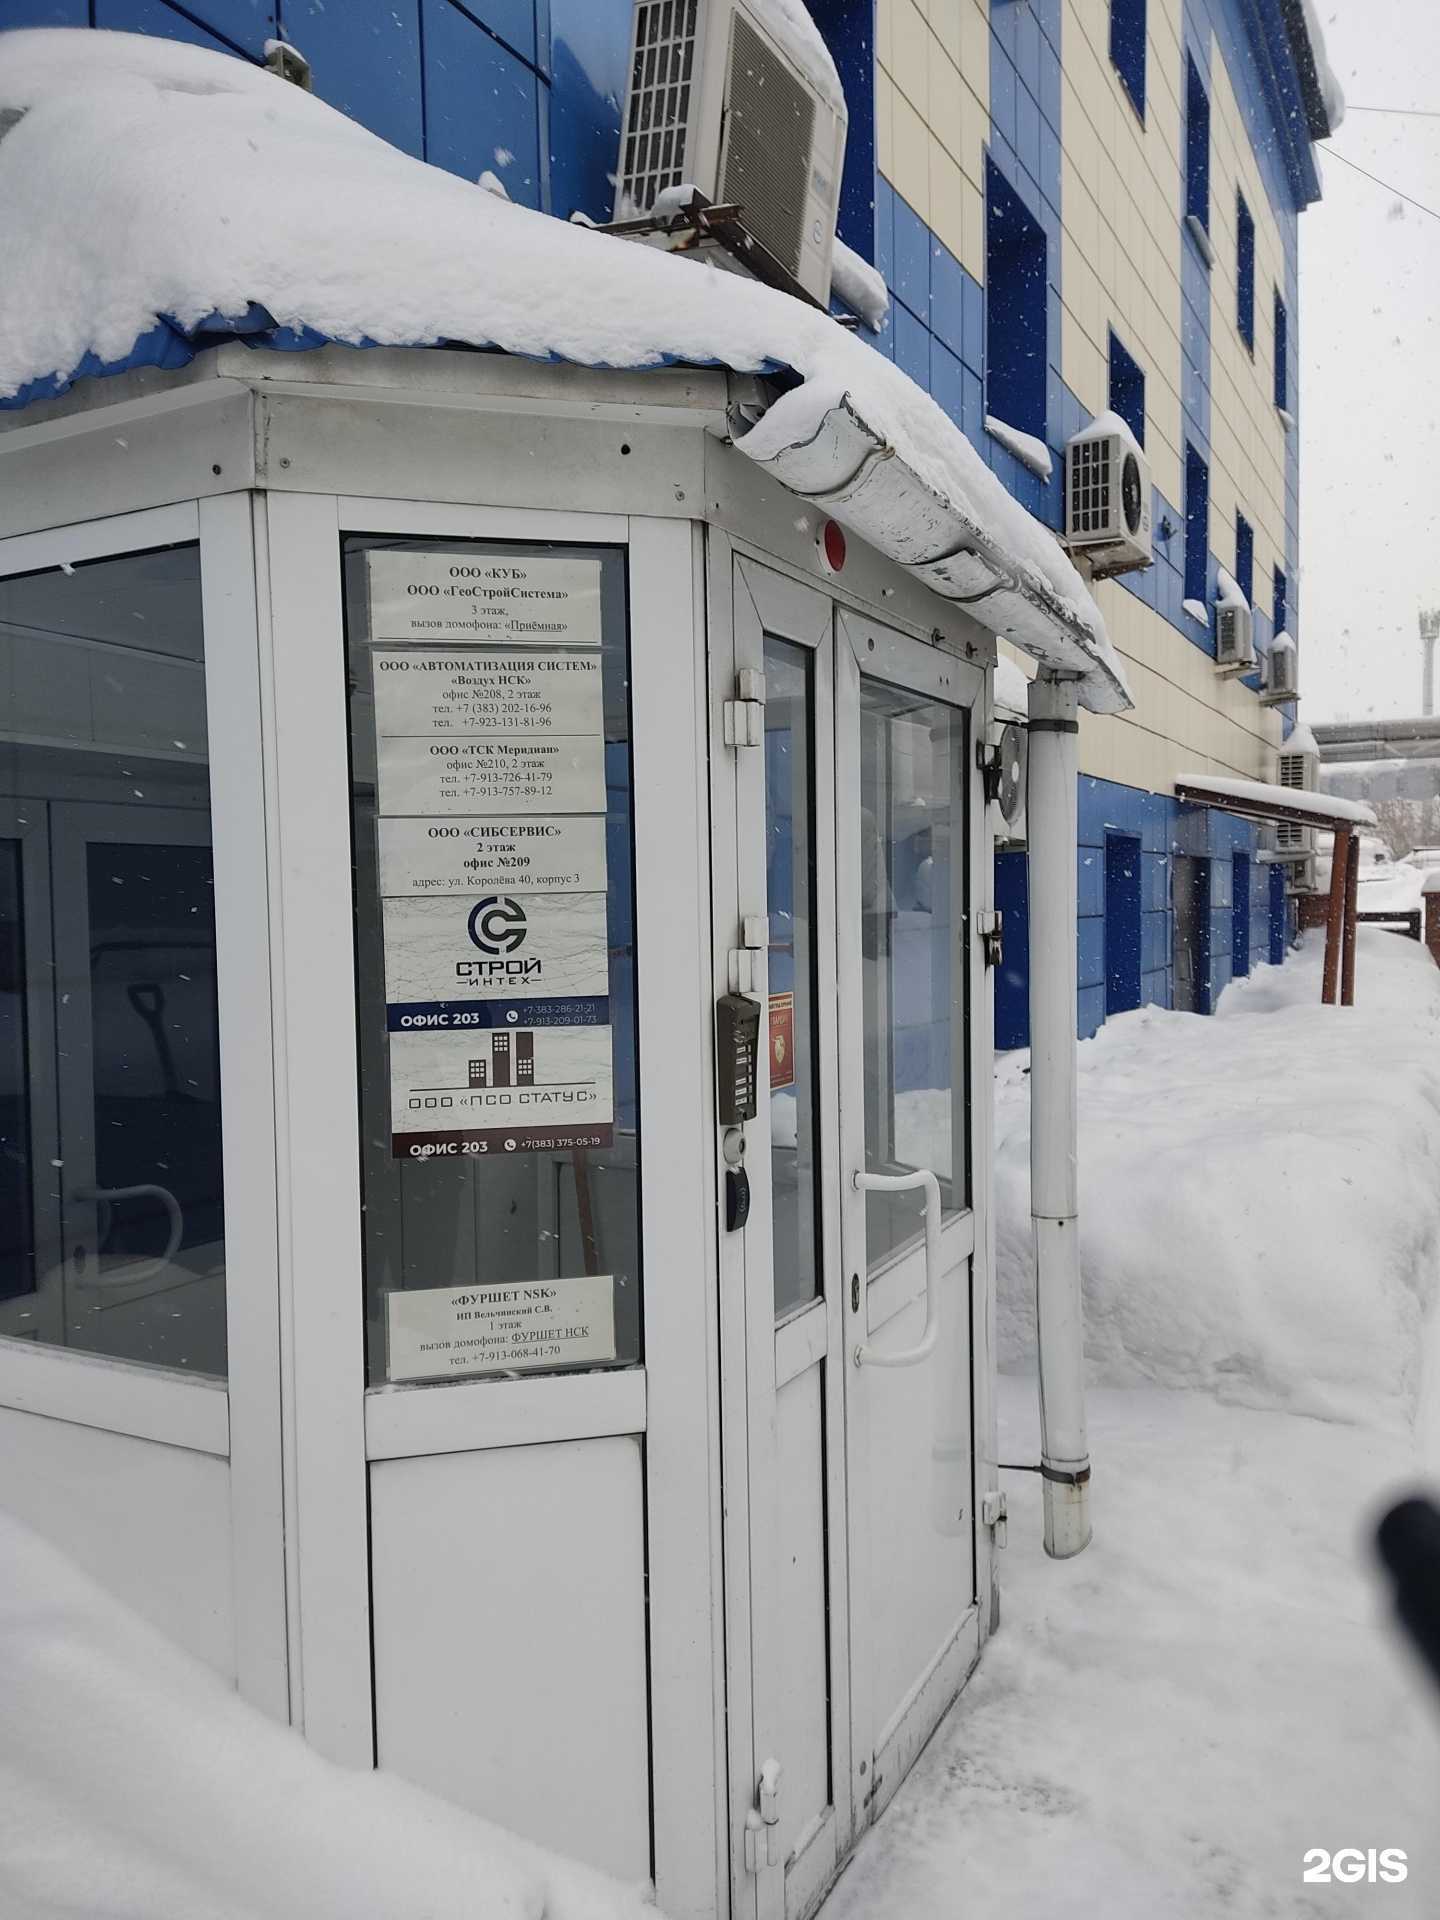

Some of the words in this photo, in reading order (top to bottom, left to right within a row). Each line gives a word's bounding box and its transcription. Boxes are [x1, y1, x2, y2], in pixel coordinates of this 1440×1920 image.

[450, 567, 481, 578] ООО
[485, 568, 527, 579] «КУБ»
[407, 585, 439, 595] ООО
[443, 586, 568, 600] «ГеоСтройСистема»
[472, 605, 477, 614] 3
[481, 608, 509, 616] этаж,
[411, 620, 442, 628] вызов
[445, 621, 501, 631] домофона:
[505, 621, 568, 632] «Приёмная»
[380, 661, 409, 671] ООО
[413, 661, 535, 673] «АВТОМАТИЗАЦИЯ
[538, 661, 597, 671] СИСТЕМ»
[451, 676, 495, 687] «Воздух
[499, 676, 531, 685] НСК»
[442, 690, 468, 700] офис
[472, 690, 505, 700] №208,
[508, 690, 514, 698] 2
[432, 705, 453, 713] тел.
[455, 704, 469, 713] +7
[472, 703, 499, 715] (383)
[502, 704, 552, 713] 202-16-96
[462, 718, 552, 727] +7-923-131-81-96
[430, 746, 459, 755] ООО
[462, 746, 493, 755] «ТСК
[497, 746, 559, 757] Меридиан»
[447, 760, 473, 770] офис
[476, 760, 509, 770] №210,
[512, 760, 518, 768] 2
[440, 775, 460, 783] тел.
[463, 773, 552, 783] +7-913-726-41-79
[440, 789, 460, 797] тел.
[463, 787, 552, 797] +7-913-757-89-12
[428, 828, 460, 837] ООО
[464, 826, 561, 837] «СИБСЕРВИС»
[477, 843, 483, 852] 2
[487, 844, 516, 852] этаж
[463, 859, 494, 870] офис
[497, 857, 530, 867] №209
[412, 878, 445, 888] адрес:
[448, 878, 464, 887] ул.
[467, 875, 516, 888] Королёва
[519, 875, 534, 886] 40,
[536, 875, 571, 886] корпус
[574, 874, 580, 883] 3
[456, 958, 541, 976] СТРОЙ
[400, 1015, 449, 1026] ОФИС
[452, 1013, 479, 1025] 203
[409, 1097, 453, 1108] ООО
[460, 1094, 511, 1106] «ПСО
[519, 1091, 597, 1104] СТАТУС»
[409, 1144, 458, 1156] ОФИС
[461, 1142, 488, 1153] 203
[521, 1138, 554, 1149] +7(383)
[557, 1137, 601, 1146] 375-05-19
[451, 1290, 520, 1306] «ФУРШЕТ
[523, 1288, 556, 1300] NSK»
[457, 1312, 472, 1321] ИП
[535, 1305, 553, 1314] С.В.
[490, 1322, 494, 1330] 1
[499, 1321, 522, 1329] этаж
[420, 1343, 451, 1351] вызов
[454, 1336, 509, 1349] домофона:
[511, 1329, 562, 1344] ФУРШЕТ
[565, 1326, 589, 1338] НСК
[449, 1356, 469, 1366] тел.
[472, 1346, 561, 1362] +7-913-068-41-70
